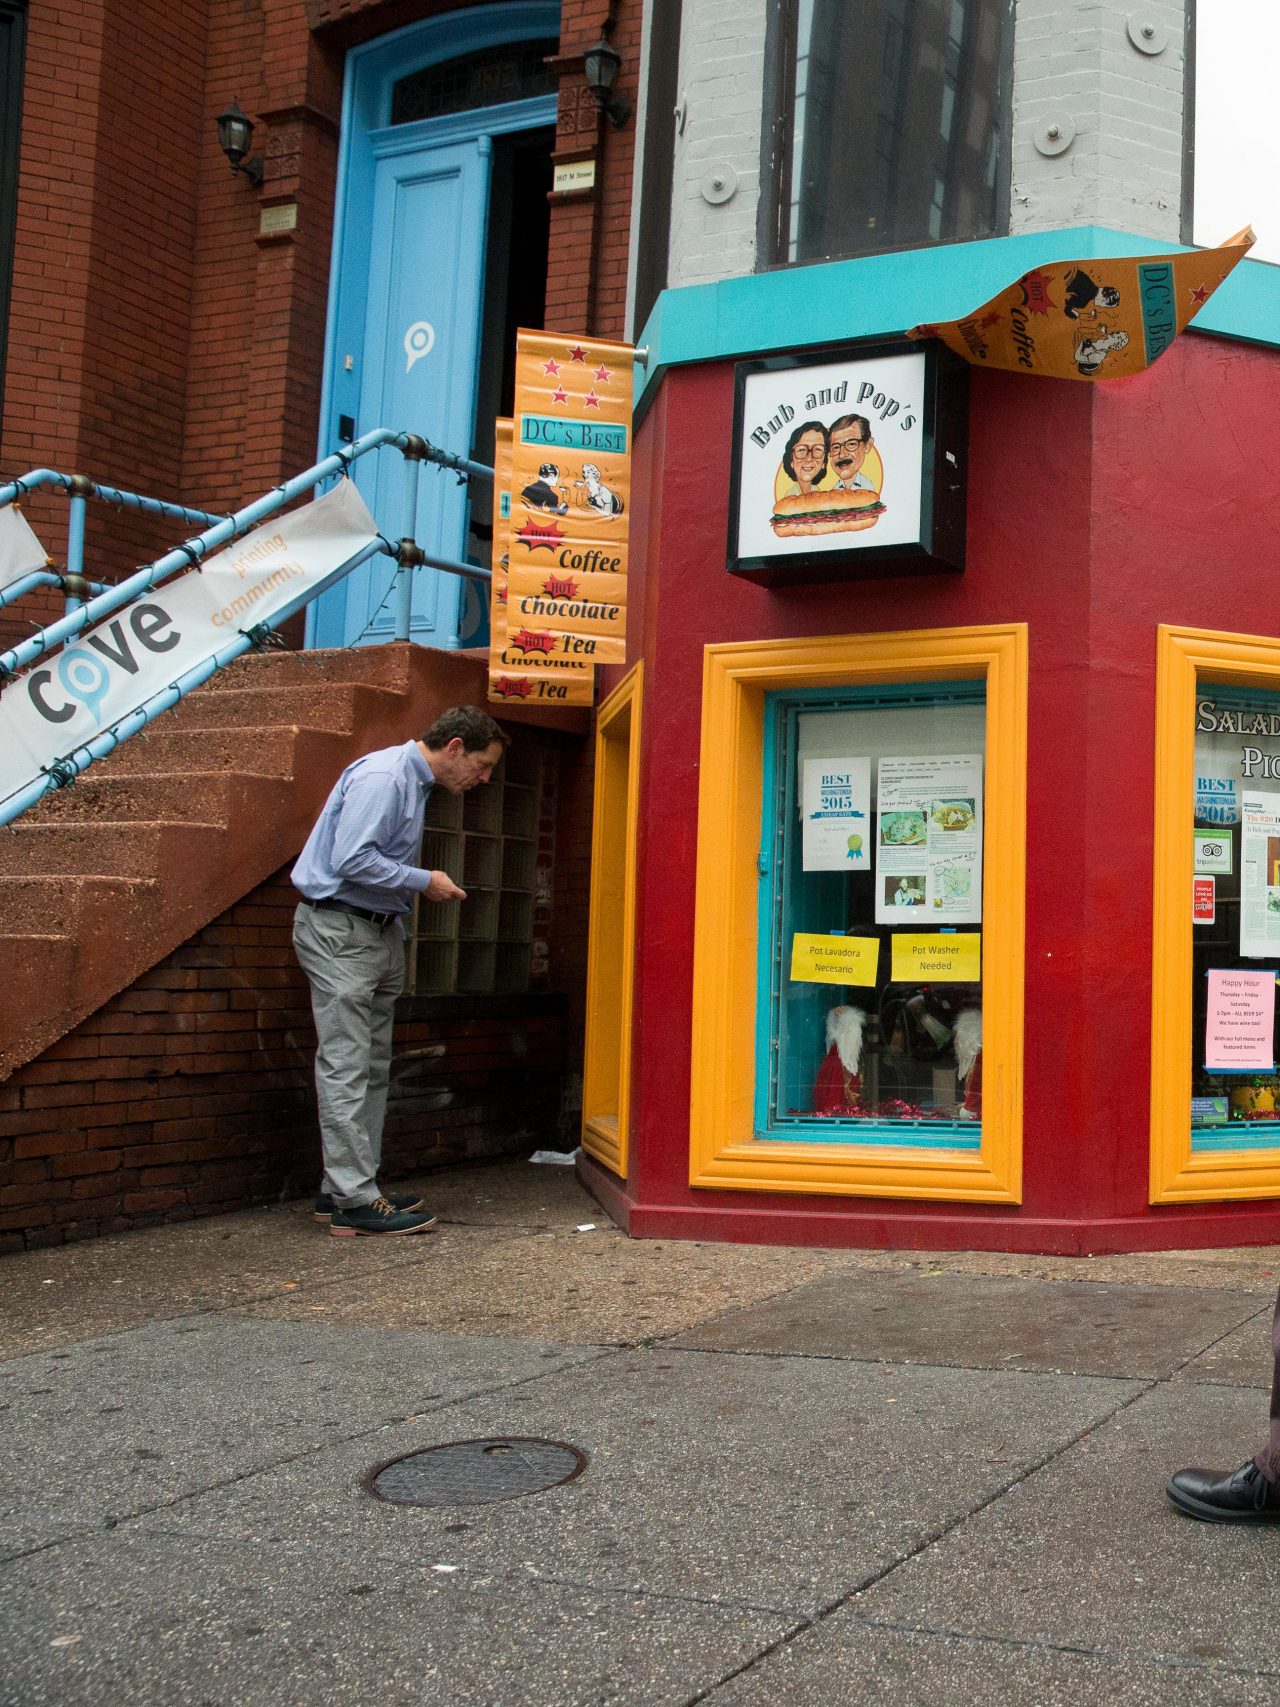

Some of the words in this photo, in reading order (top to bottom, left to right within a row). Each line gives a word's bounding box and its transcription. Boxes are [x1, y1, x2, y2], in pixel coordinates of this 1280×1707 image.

[576, 171, 592, 179] Street
[1010, 307, 1035, 368] Coffee
[1149, 322, 1173, 360] BES
[750, 404, 795, 449] Bub
[804, 380, 848, 410] and
[857, 381, 917, 432] Pop's
[581, 424, 624, 450] BEST
[232, 534, 288, 579] printing
[559, 550, 621, 573] Coffee
[211, 561, 305, 628] community
[551, 583, 573, 593] HOT
[520, 595, 620, 621] Chocolate
[525, 636, 546, 648] HOT
[562, 634, 597, 655] Tea
[537, 680, 568, 699] Tea
[822, 774, 852, 784] BEST
[1197, 777, 1236, 792] BEST
[821, 797, 852, 810] 2015
[1197, 805, 1237, 823] 2015
[810, 946, 823, 955] Pot
[825, 947, 861, 958] Lavadora
[912, 946, 926, 955] Pot
[928, 946, 960, 955] Washer
[815, 964, 853, 974] Necesario
[920, 961, 952, 970] Needed
